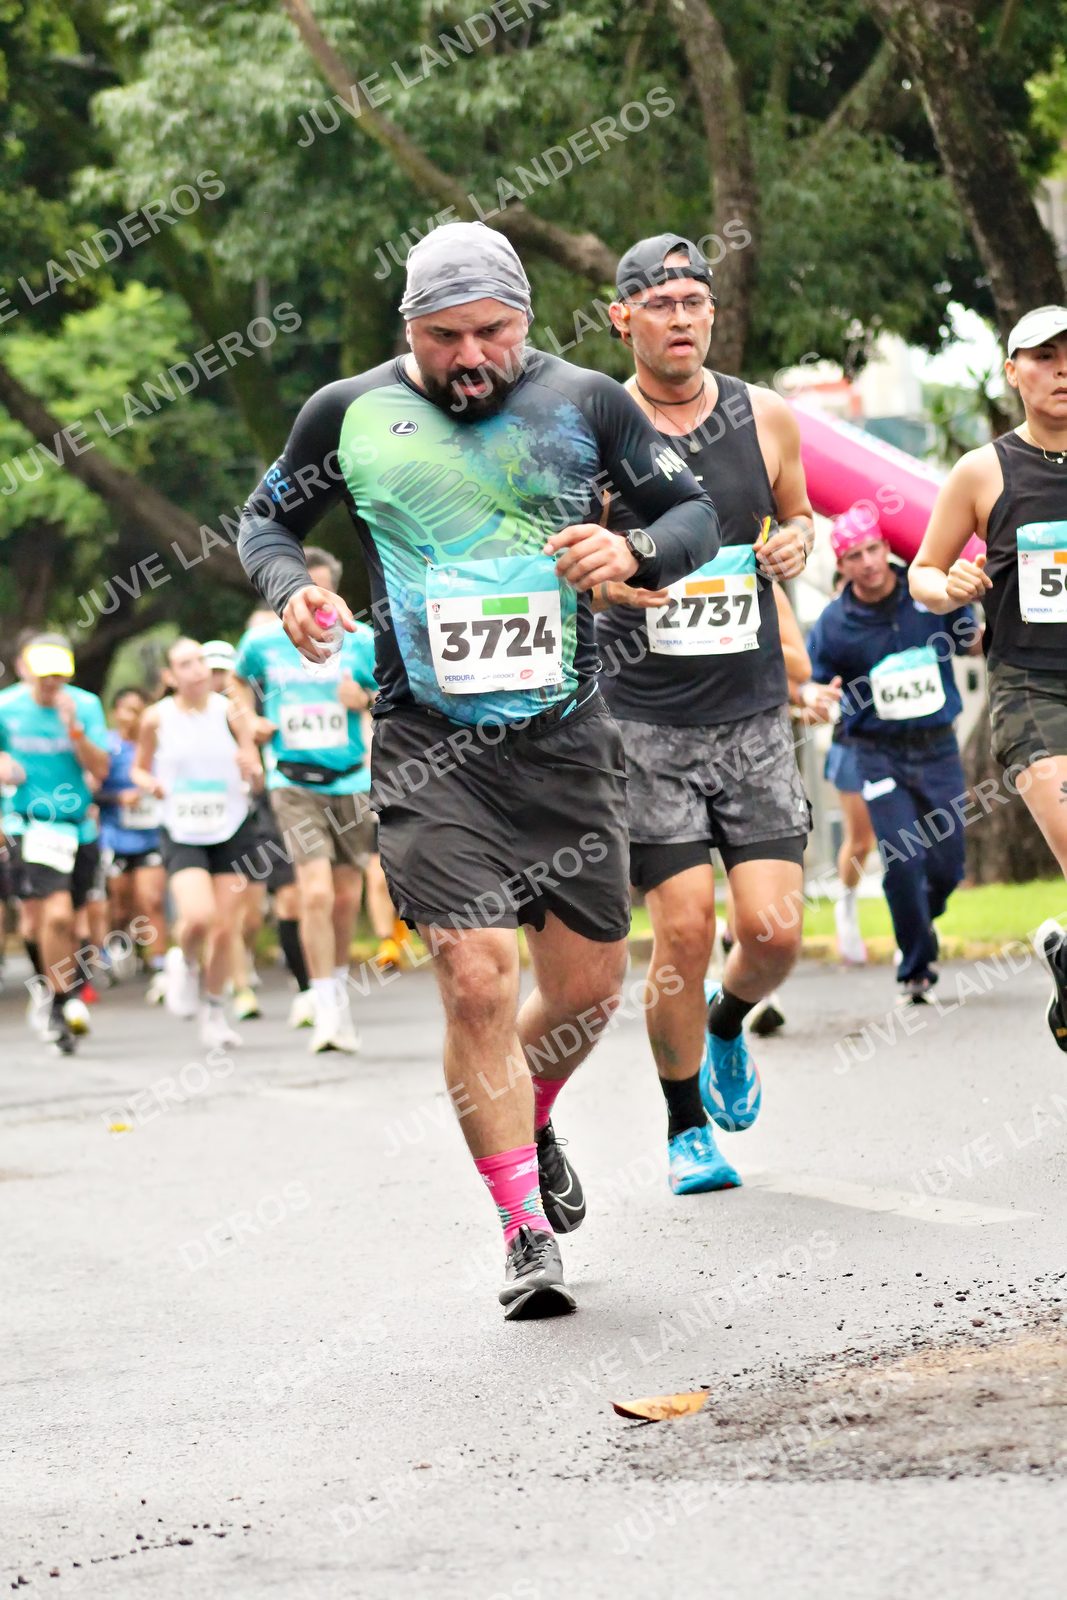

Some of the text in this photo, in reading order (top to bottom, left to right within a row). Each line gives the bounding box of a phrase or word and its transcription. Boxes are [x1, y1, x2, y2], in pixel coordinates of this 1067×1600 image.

[656, 594, 753, 629] 2737
[440, 616, 556, 661] 3724
[444, 673, 475, 682] PERDURA
[881, 678, 936, 703] 6434
[287, 713, 342, 732] 6410
